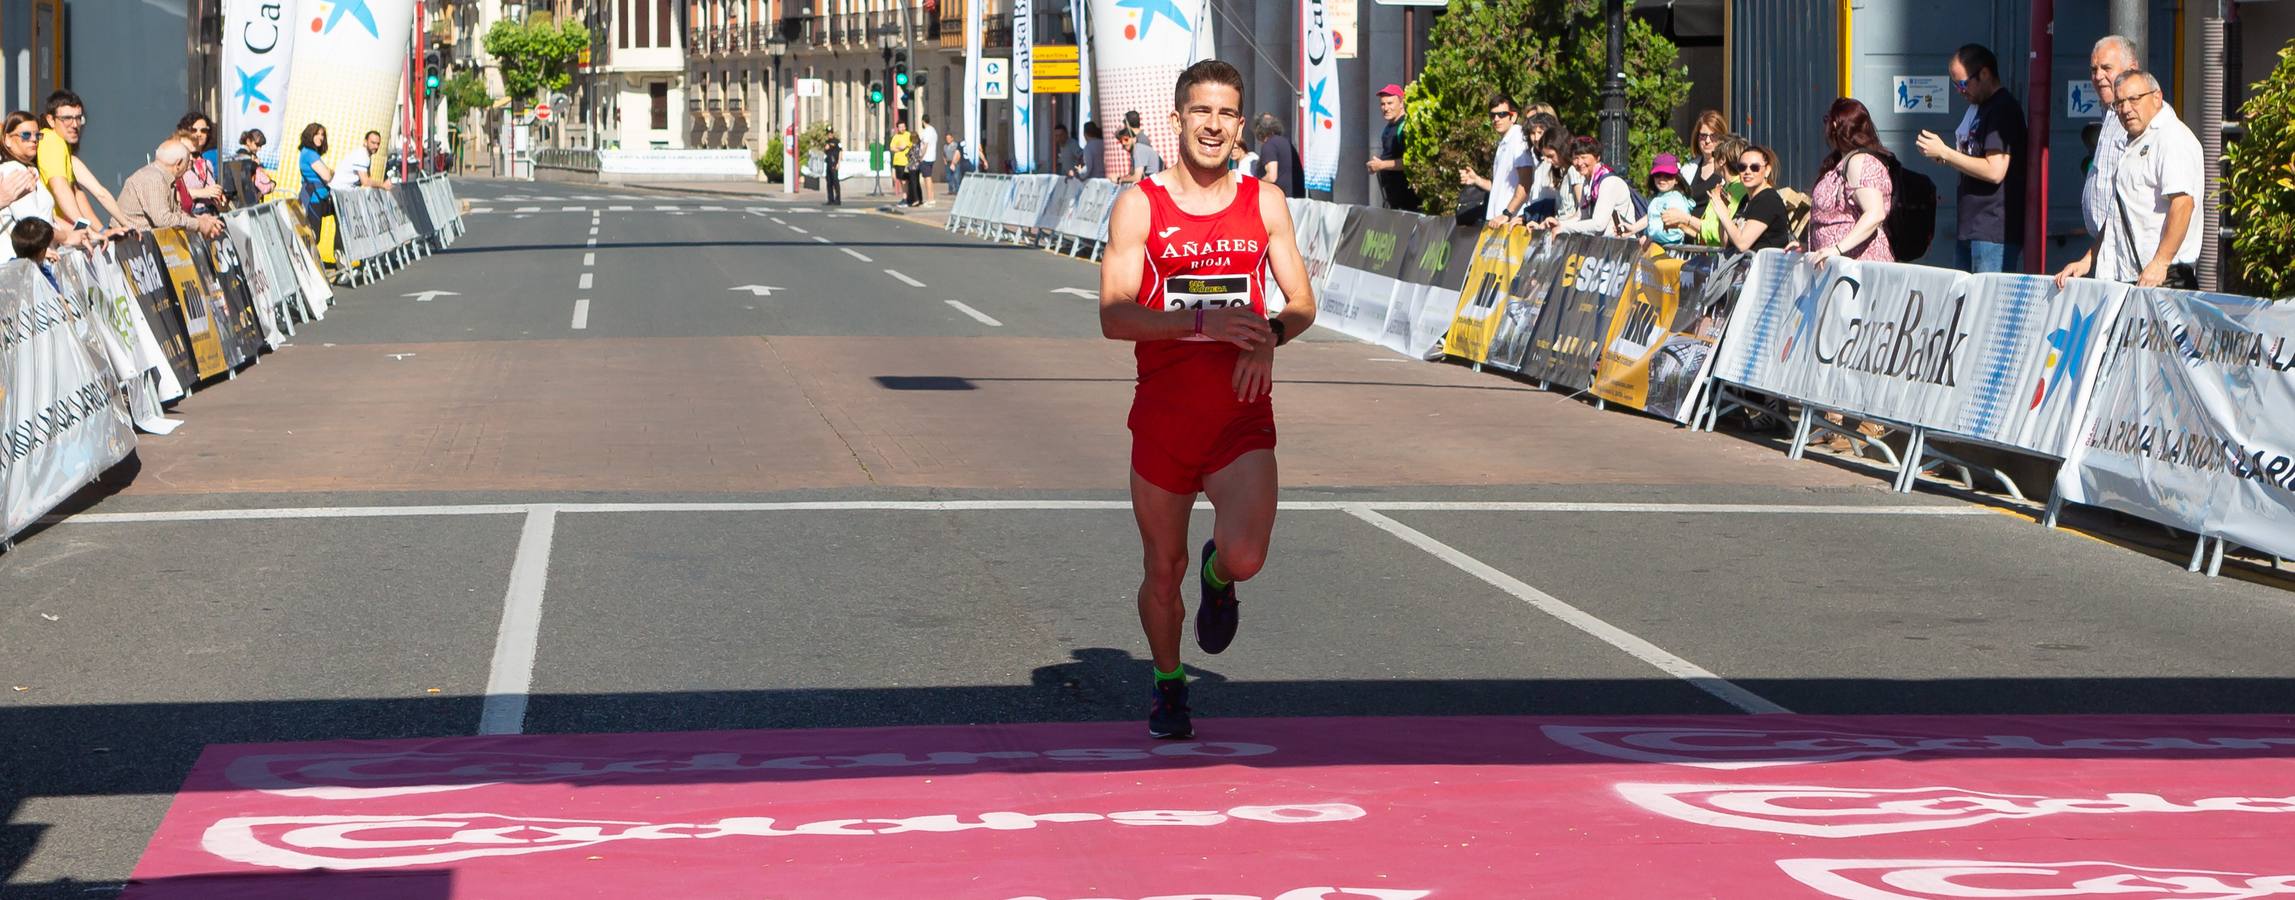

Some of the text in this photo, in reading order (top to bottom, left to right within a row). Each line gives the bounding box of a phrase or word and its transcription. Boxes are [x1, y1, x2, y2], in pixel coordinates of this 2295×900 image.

[1160, 239, 1259, 259] AÑARES
[1191, 257, 1231, 270] RIOJA
[1815, 275, 1968, 388] CaixaBank
